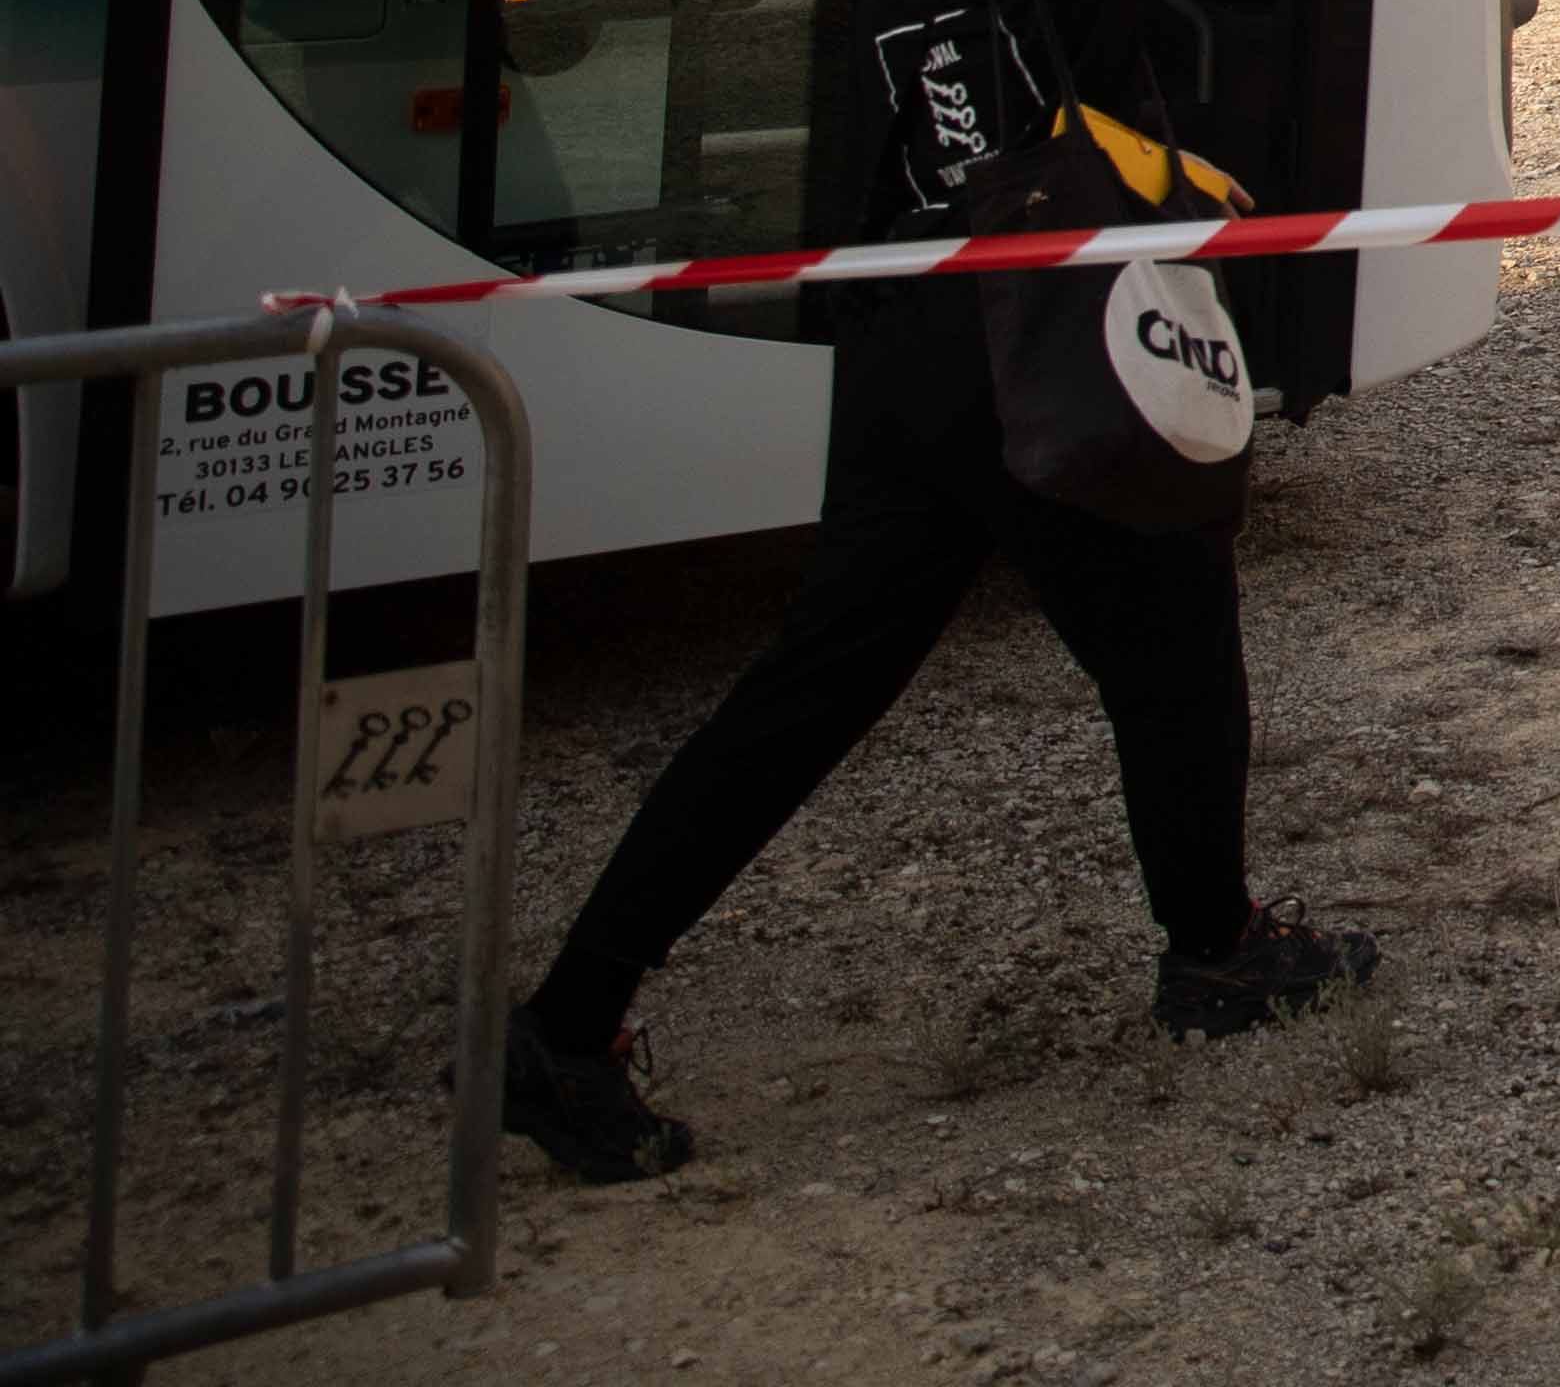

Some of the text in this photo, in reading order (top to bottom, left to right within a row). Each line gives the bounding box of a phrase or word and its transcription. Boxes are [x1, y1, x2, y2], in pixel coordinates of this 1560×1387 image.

[185, 357, 448, 423] BOUSSE
[189, 433, 230, 452] rue
[238, 428, 267, 446] du
[355, 405, 470, 433] Montagné
[196, 455, 270, 480] 30133
[335, 435, 433, 463] ANGLES
[158, 489, 216, 516] Tél.
[226, 482, 268, 507] 04
[333, 470, 371, 494] 25
[382, 463, 418, 488] 37
[428, 457, 465, 481] 56
